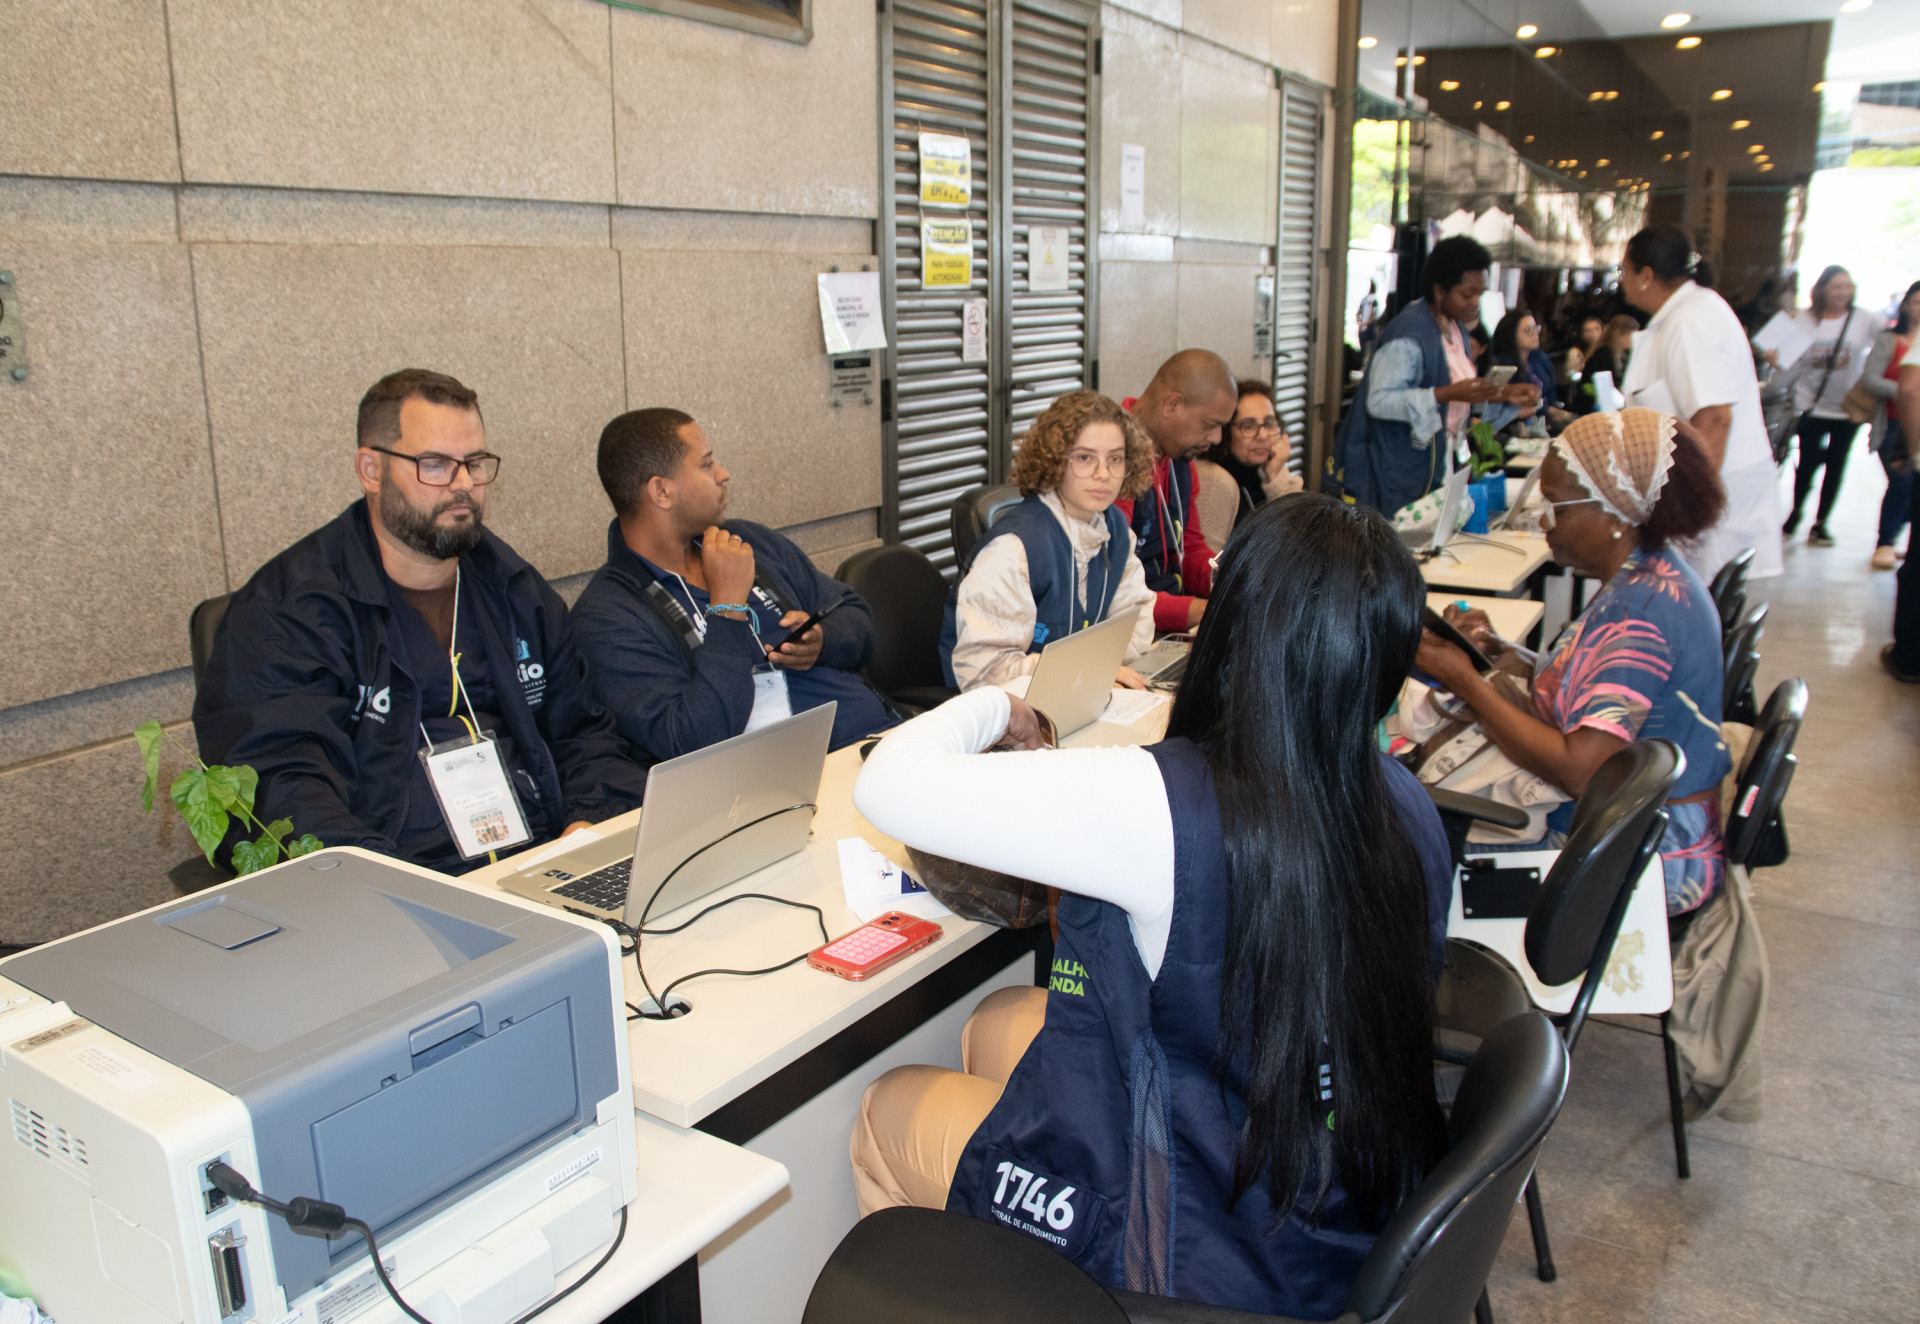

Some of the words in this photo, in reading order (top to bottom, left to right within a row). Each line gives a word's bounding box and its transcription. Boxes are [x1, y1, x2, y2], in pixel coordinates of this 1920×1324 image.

[993, 1161, 1077, 1231] 1746
[1012, 1217, 1021, 1228] DE
[1021, 1222, 1068, 1247] ATENDIMENTO
